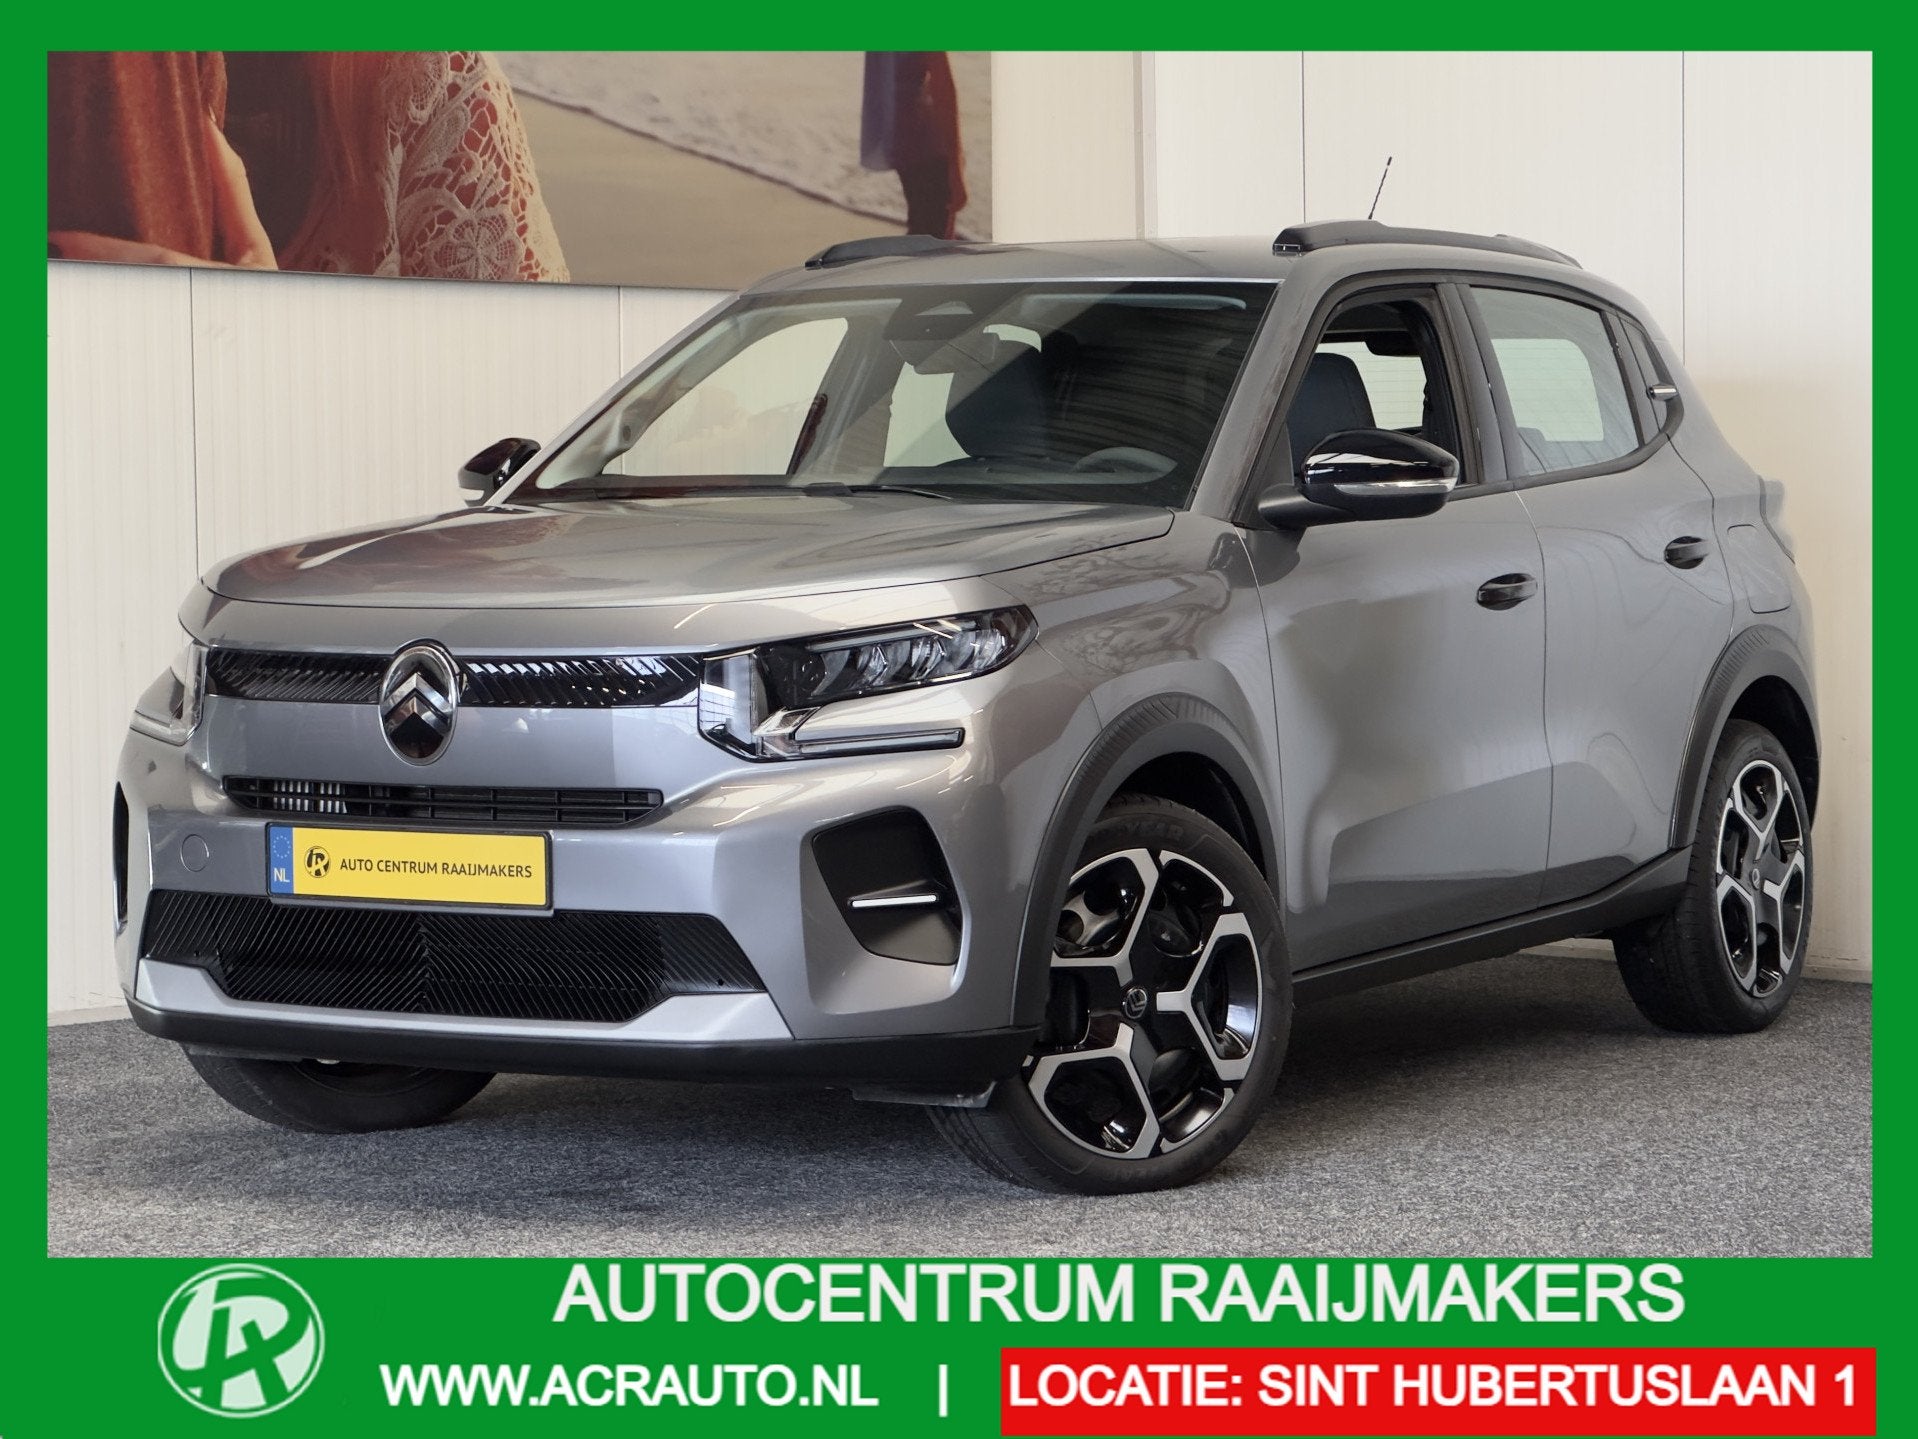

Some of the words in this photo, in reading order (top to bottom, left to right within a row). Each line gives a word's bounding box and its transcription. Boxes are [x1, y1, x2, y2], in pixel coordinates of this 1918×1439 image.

[273, 867, 291, 883] NL
[340, 858, 373, 872] AUTO
[377, 859, 438, 875] CENTRUM
[441, 862, 532, 878] RAAIJMAKERS
